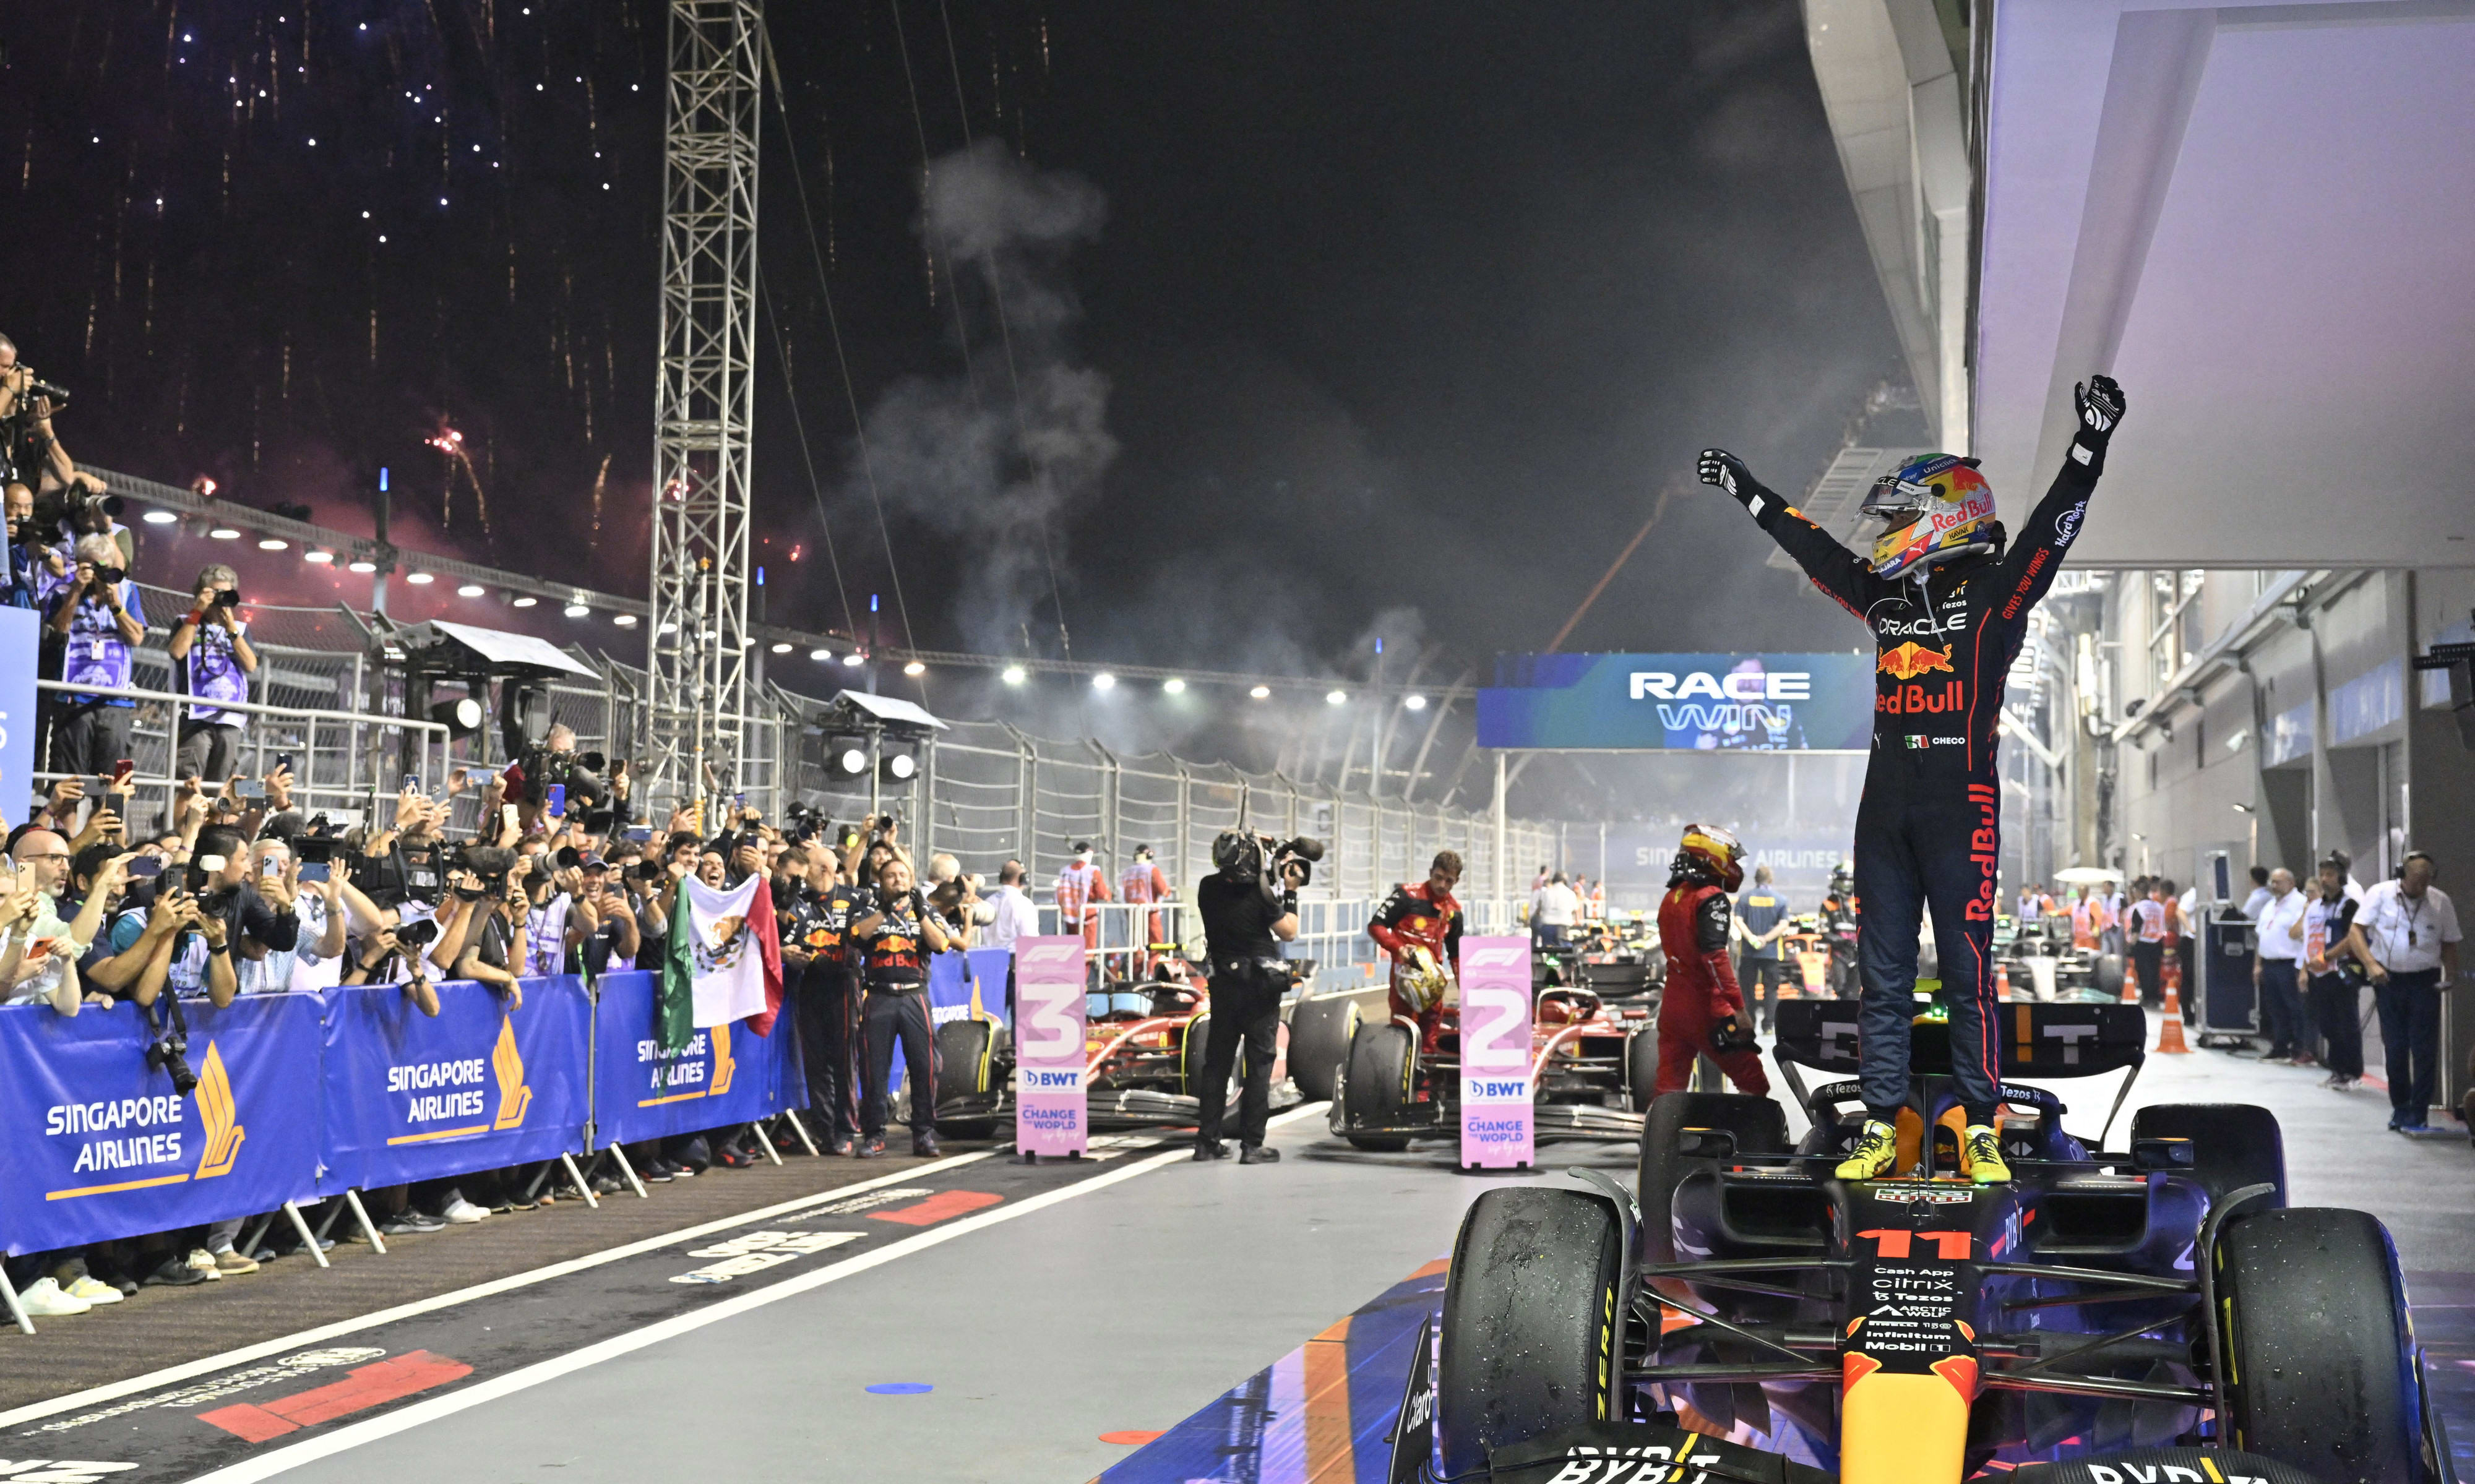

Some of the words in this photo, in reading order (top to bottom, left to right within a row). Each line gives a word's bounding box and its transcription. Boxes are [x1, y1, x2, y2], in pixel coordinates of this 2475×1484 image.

[1924, 458, 1958, 474] Uniclick
[1930, 504, 1967, 532] Red
[1967, 494, 1993, 518] Bull
[2054, 521, 2073, 547] Hard
[2066, 500, 2086, 523] Rock
[1949, 526, 1969, 539] KAVAK
[2002, 594, 2023, 620] GIVES
[2015, 575, 2033, 595] YOU
[2026, 547, 2050, 577] WINGS
[1879, 612, 1968, 636] ORACLE
[1630, 672, 1811, 700] RACE
[1906, 680, 1964, 713] Bull
[1656, 704, 1792, 731] WIN
[1932, 737, 1966, 745] CHECO
[1968, 783, 1995, 852] Bull
[1753, 849, 1839, 866] AIRLINES
[1965, 854, 1995, 922] Red
[1021, 984, 1081, 1058] 3
[1466, 989, 1526, 1066] 2
[387, 1058, 484, 1092] SINGAPORE
[1041, 1073, 1078, 1086] BWT
[1487, 1083, 1525, 1097] BWT
[1835, 1083, 1862, 1094] Tezos
[2000, 1085, 2031, 1100] Tezos
[46, 1096, 183, 1136] SINGAPORE
[407, 1091, 484, 1124] AIRLINES
[1022, 1110, 1076, 1120] CHANGE
[1033, 1121, 1076, 1130] WORLD
[1468, 1121, 1523, 1131] CHANGE
[1479, 1133, 1524, 1142] WORLD
[73, 1132, 182, 1173] AIRLINES
[1856, 1230, 1971, 1259] 11
[1919, 1269, 1954, 1277] App
[1895, 1293, 1953, 1302] Tezos
[1865, 1341, 1926, 1352] Mobil
[1866, 1331, 1951, 1340] Infinitum
[1596, 1284, 1614, 1422] ZERO
[1407, 1389, 1431, 1434] Claro
